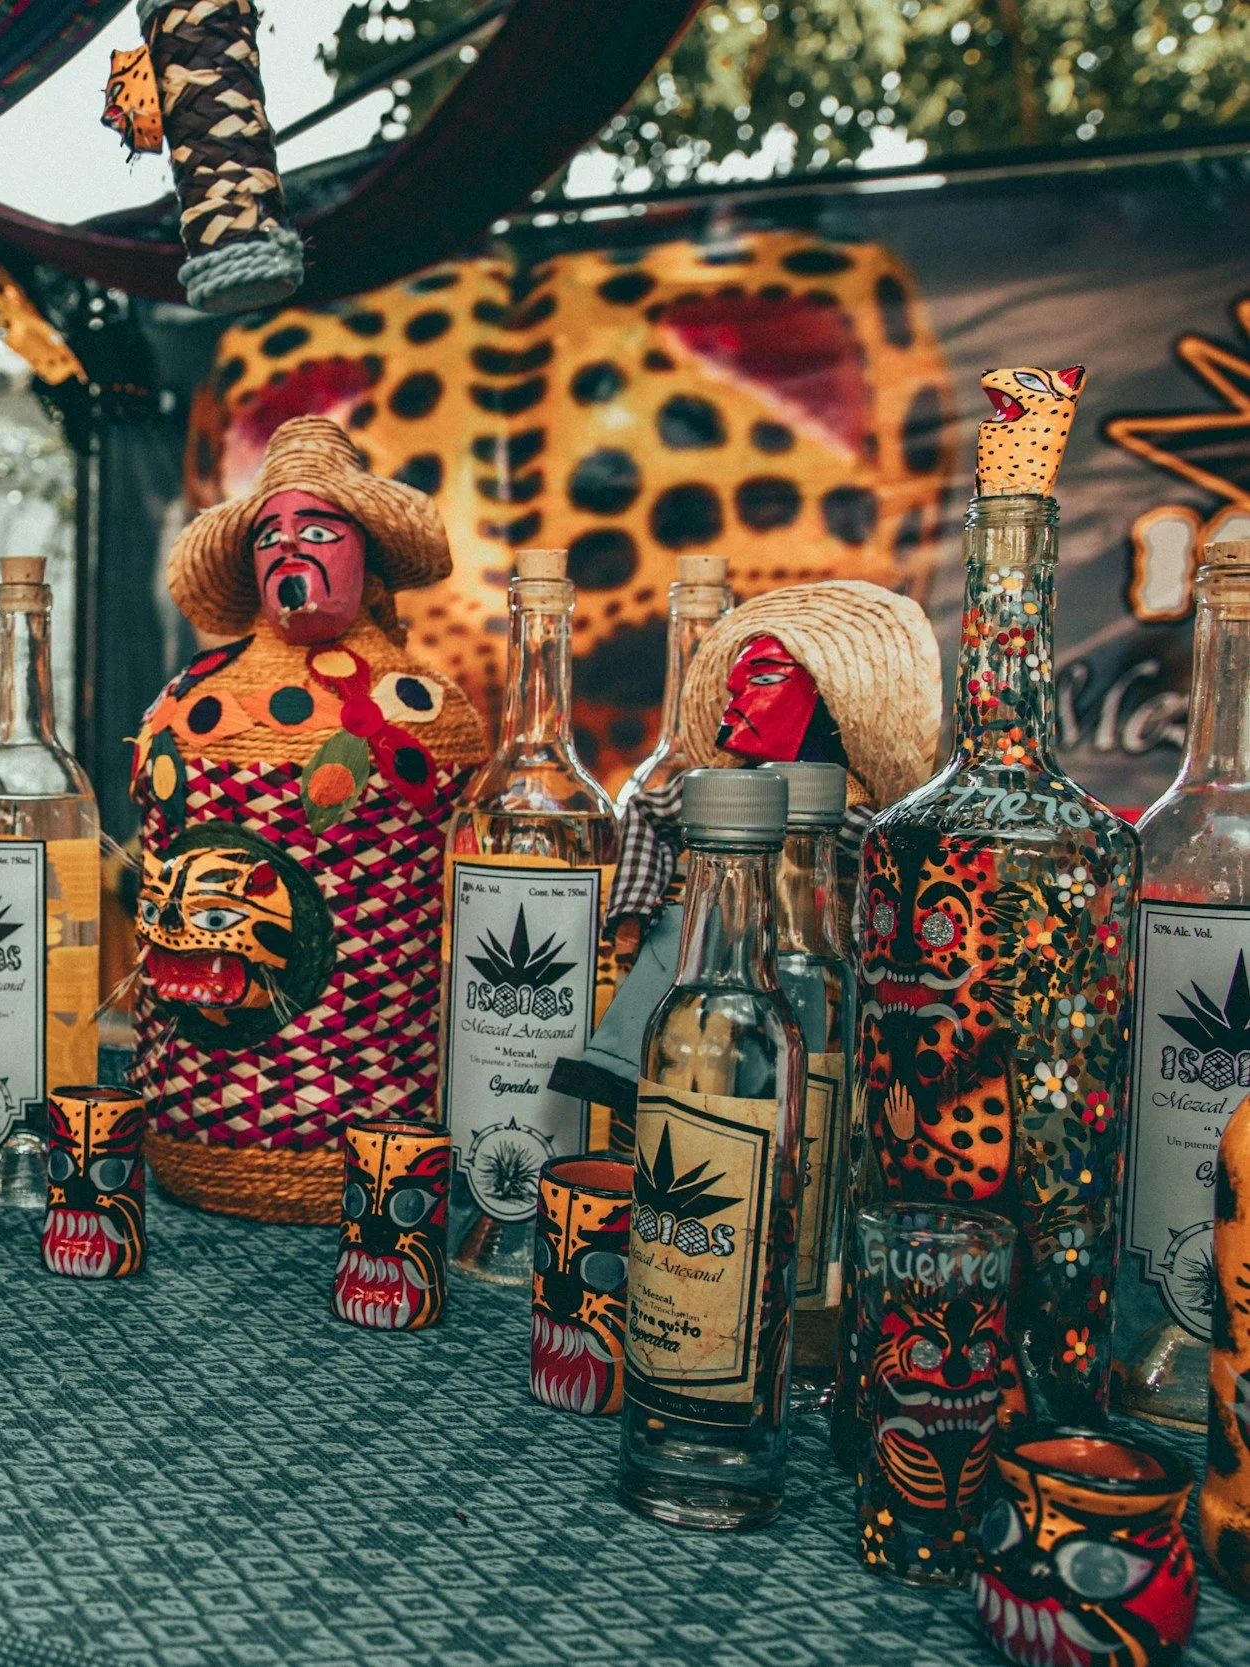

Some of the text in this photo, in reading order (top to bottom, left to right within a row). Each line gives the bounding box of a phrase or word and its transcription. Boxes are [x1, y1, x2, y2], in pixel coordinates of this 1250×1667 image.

[1153, 924, 1212, 938] 50% Alc. Vol.
[461, 1017, 577, 1040] Mezcal Artesanal
[1152, 1090, 1228, 1114] Mezcal
[1166, 1135, 1218, 1151] Un puente
[654, 1256, 725, 1283] Artesanal
